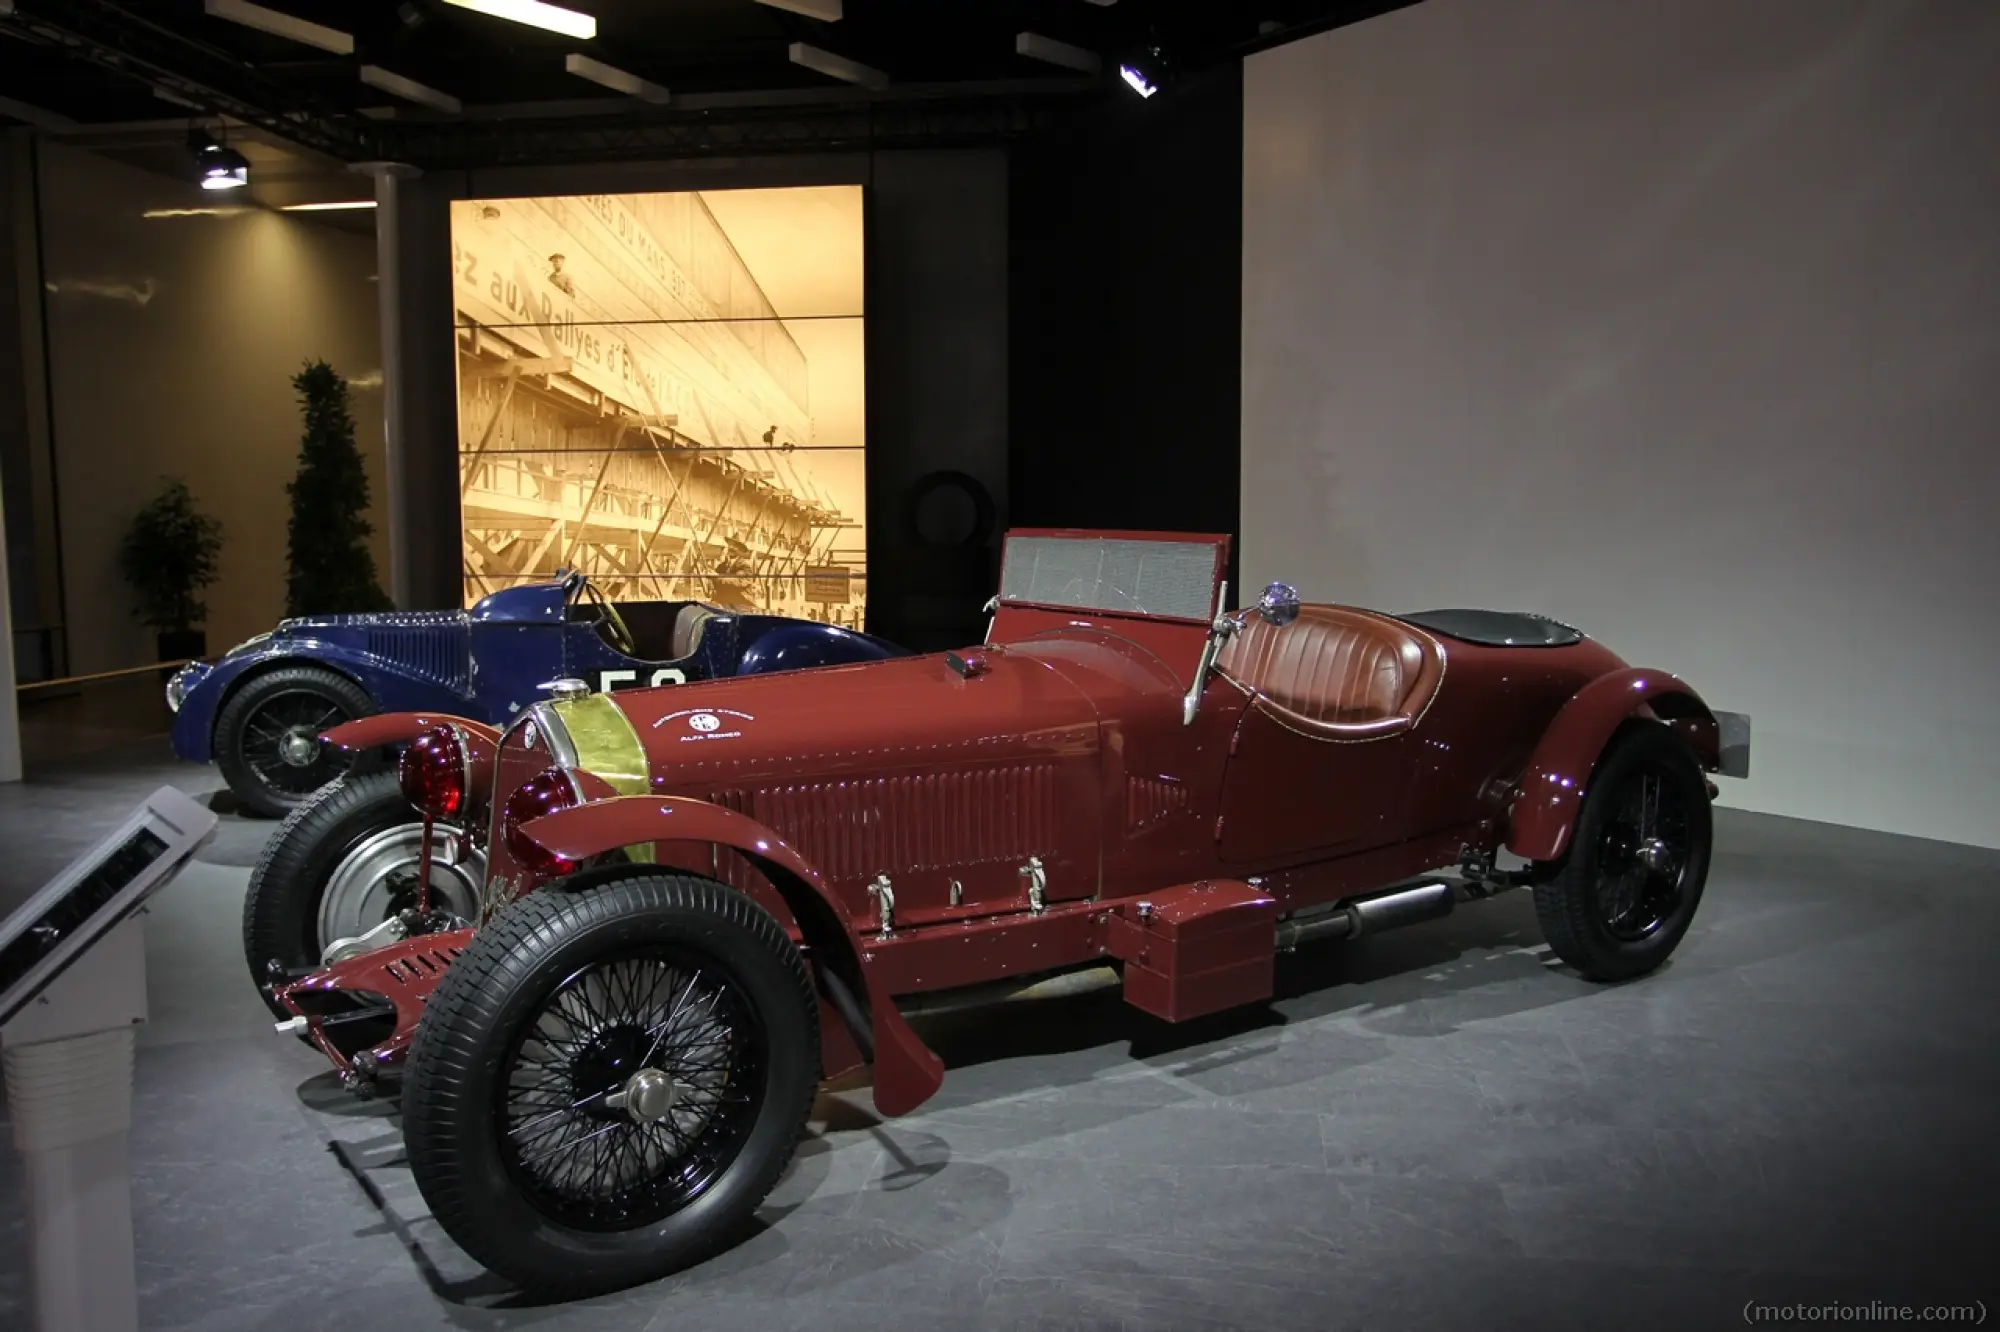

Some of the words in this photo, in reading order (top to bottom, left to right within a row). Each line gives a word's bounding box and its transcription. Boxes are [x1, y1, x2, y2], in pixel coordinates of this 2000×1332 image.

[619, 211, 634, 246] DU
[490, 269, 531, 323] aux
[542, 291, 601, 365] Rallyes
